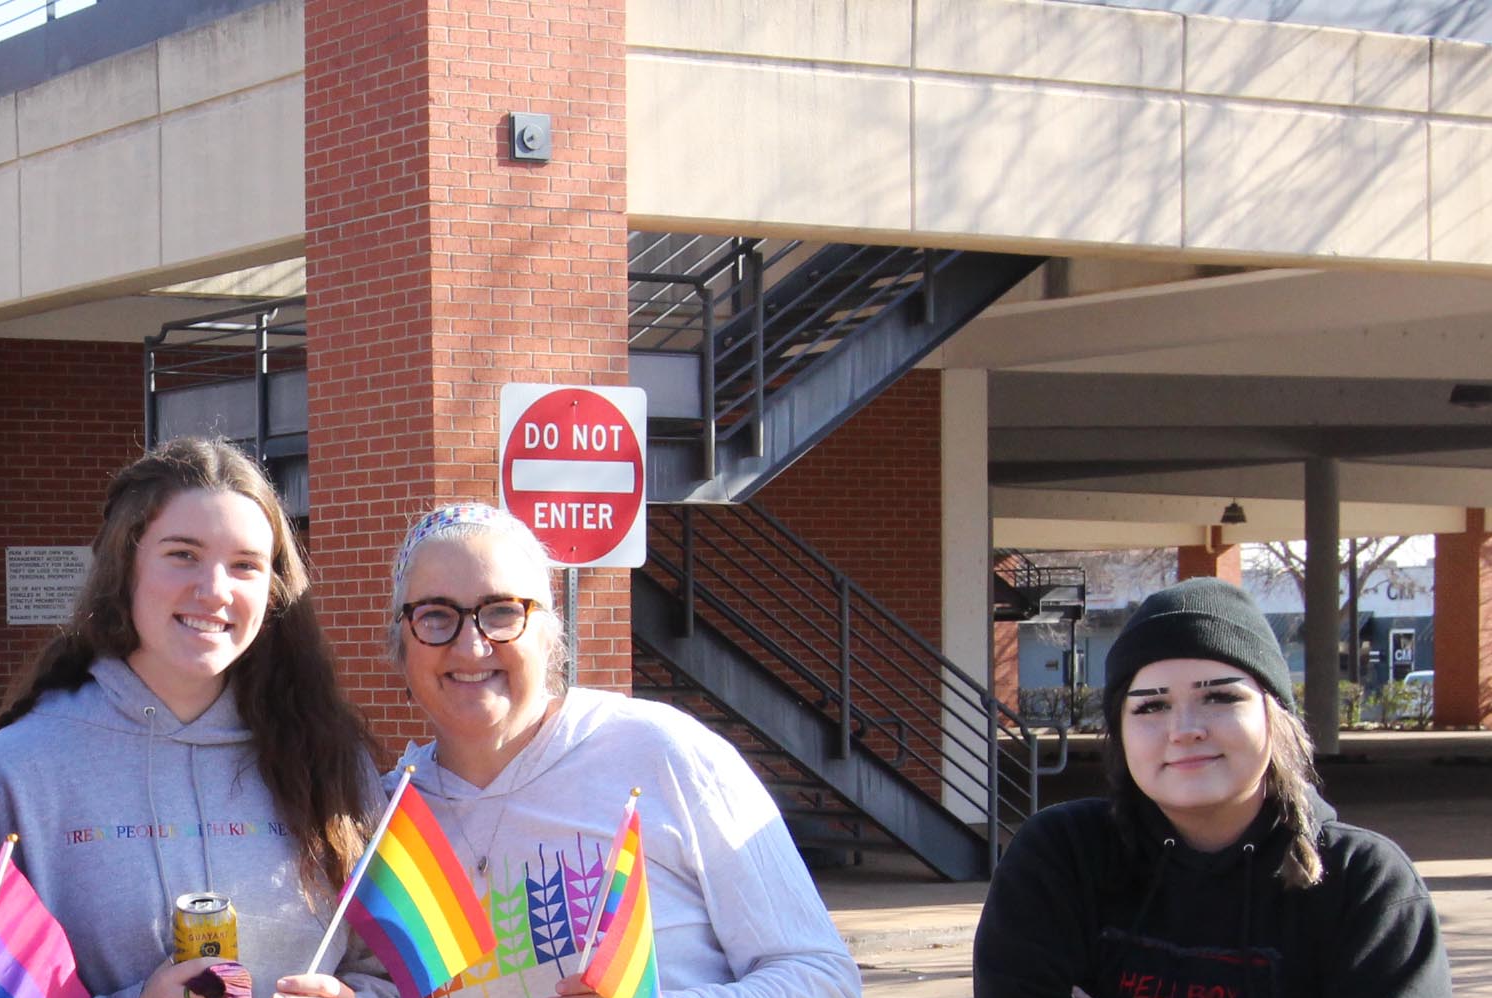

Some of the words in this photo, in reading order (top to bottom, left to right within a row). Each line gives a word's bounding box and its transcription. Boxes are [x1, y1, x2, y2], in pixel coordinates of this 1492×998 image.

[524, 422, 559, 450] DO
[572, 423, 624, 452] NOT
[534, 502, 613, 530] ENTER
